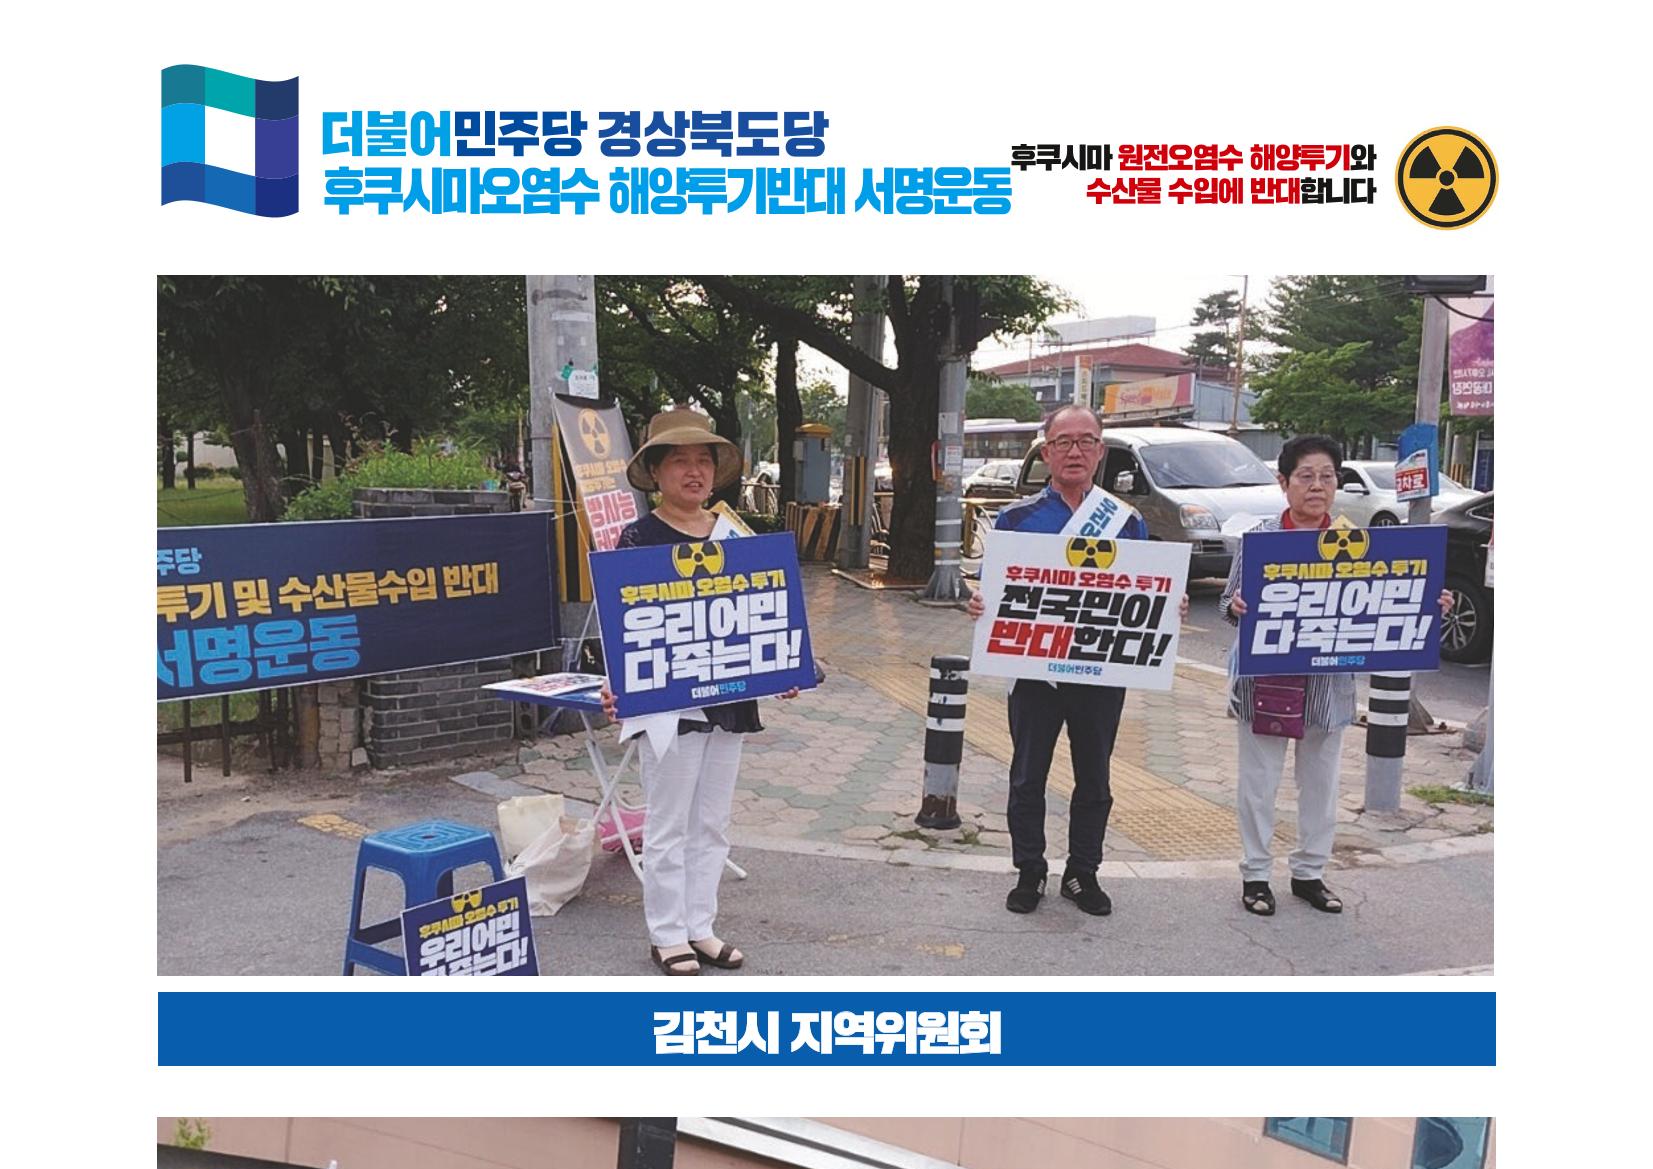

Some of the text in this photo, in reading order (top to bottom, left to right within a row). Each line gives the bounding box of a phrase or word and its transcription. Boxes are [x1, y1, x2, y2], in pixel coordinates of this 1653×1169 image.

[233, 578, 272, 617] 및
[442, 562, 499, 599] 반대
[620, 569, 786, 605] 후쿠시마 오염수 투기
[1006, 565, 1172, 593] 후쿠시마 오염수 투기
[1263, 559, 1428, 581] 후쿠시마 오염수 투기
[997, 584, 1168, 630] 전국민이
[987, 620, 1173, 667] 반대한다!
